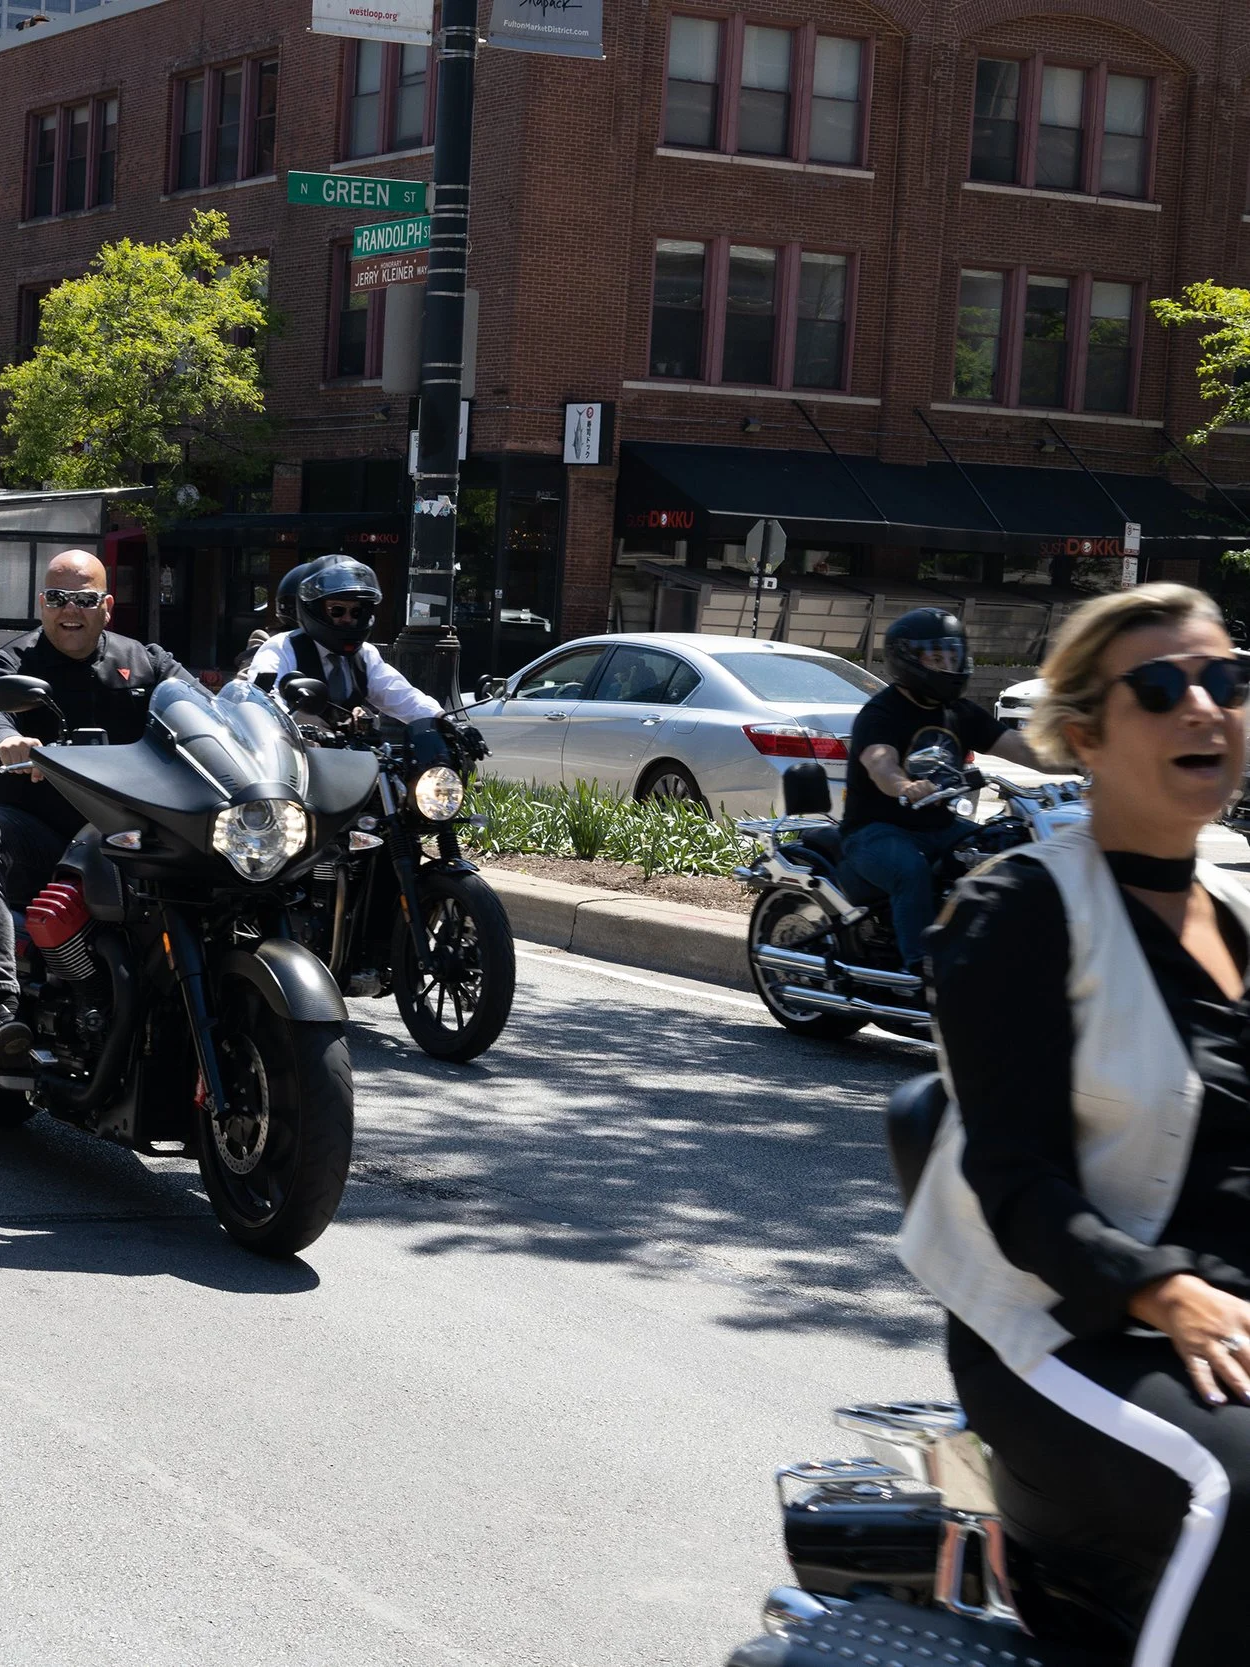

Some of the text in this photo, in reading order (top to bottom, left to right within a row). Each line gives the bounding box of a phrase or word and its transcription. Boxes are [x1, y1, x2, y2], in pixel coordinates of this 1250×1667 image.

[349, 8, 398, 21] westloop.org
[503, 20, 589, 36] FultonMarketDistrict.com
[300, 179, 416, 206] N GREEN ST
[362, 222, 423, 252] RANDOLPH
[354, 265, 428, 287] JERRY KLEINER WAY
